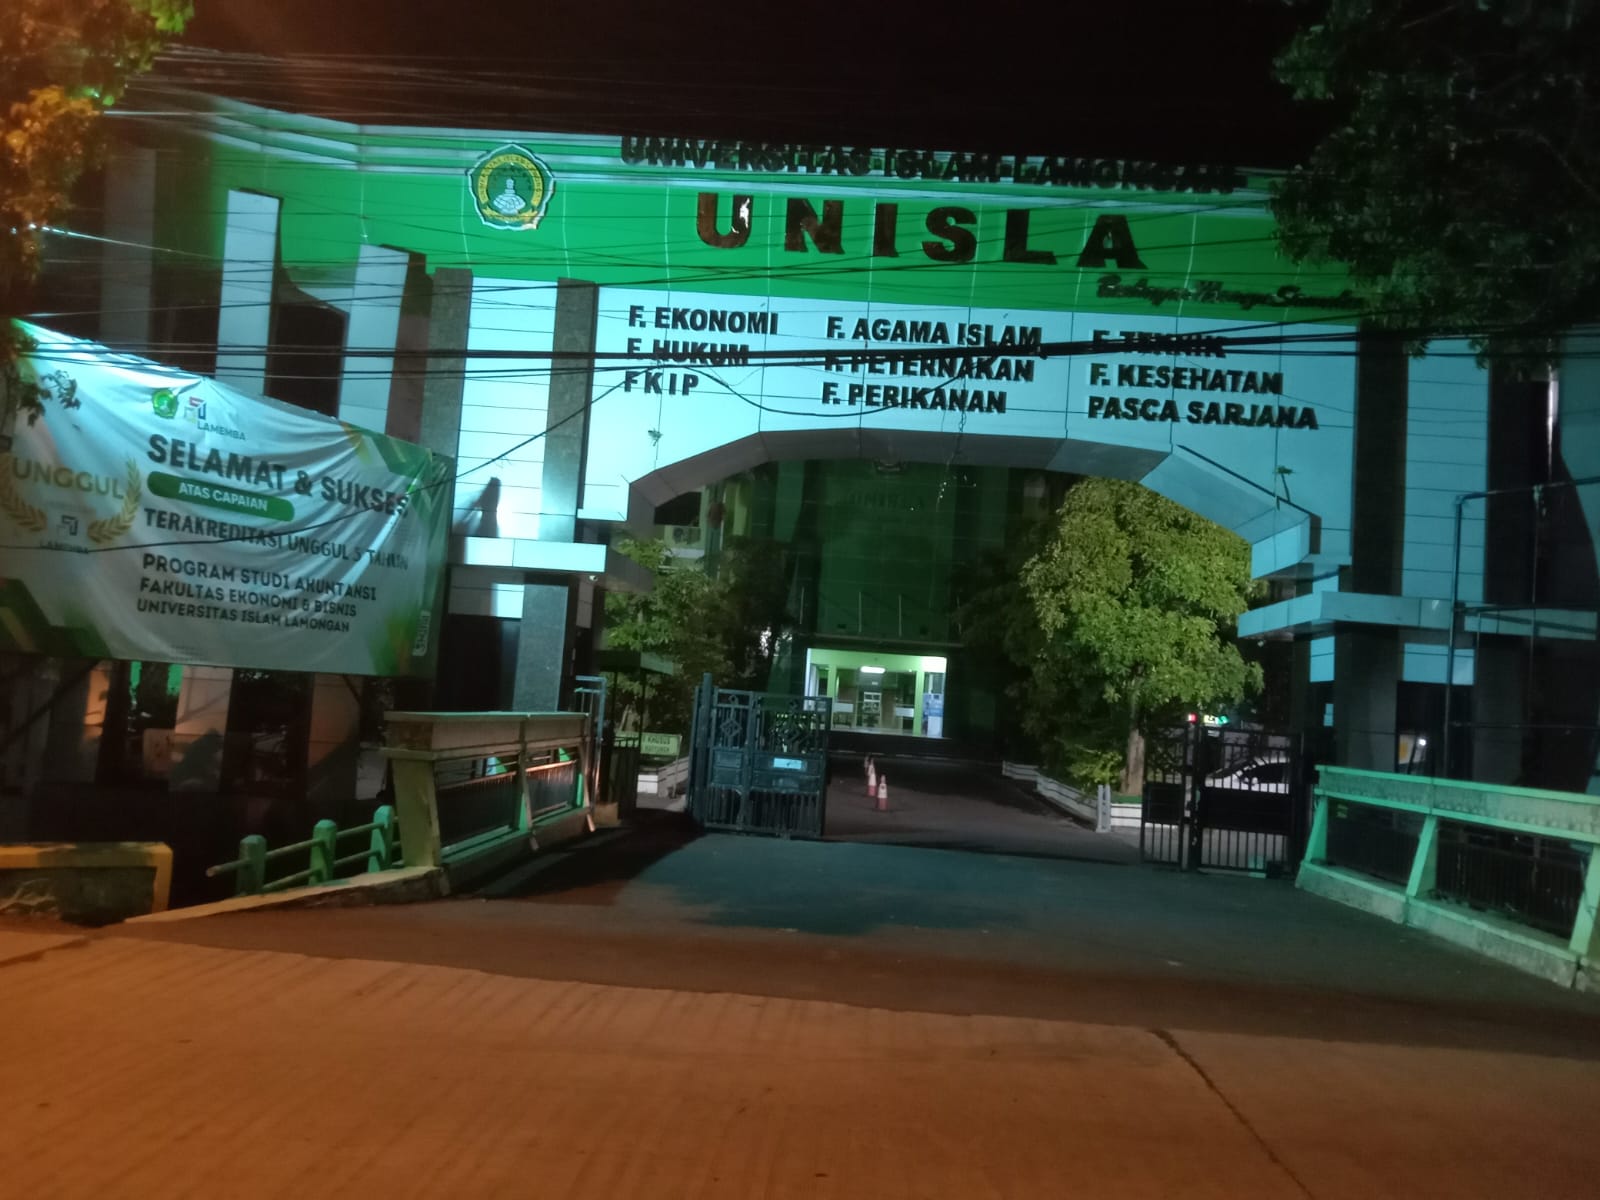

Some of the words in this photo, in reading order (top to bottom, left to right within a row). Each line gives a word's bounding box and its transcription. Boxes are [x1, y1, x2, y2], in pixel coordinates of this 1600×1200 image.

[696, 192, 1148, 269] UNISLA
[629, 305, 646, 328] F.
[655, 306, 778, 335] EKONOMI
[827, 316, 845, 339] F.
[852, 318, 950, 345] AGAMA
[957, 323, 1042, 348] ISLAM
[653, 339, 749, 366] HUKUM
[1090, 363, 1111, 386] F.
[1117, 364, 1284, 395] KESEHATAN
[822, 382, 841, 404] F.
[848, 383, 1007, 414] PERIKANAN
[1088, 396, 1180, 422] PASCA
[1187, 401, 1319, 430] SARJANA
[12, 458, 125, 500] UNGGUL
[147, 433, 286, 490] SELAMAT
[294, 470, 313, 497] &
[320, 476, 409, 518] SUKSES
[178, 483, 210, 499] ATAS
[212, 489, 268, 511] CAPAIAN
[144, 508, 283, 549] TERAKREDITASI
[287, 535, 350, 561] UNGGUL
[143, 553, 235, 581] PROGRAM
[240, 568, 290, 590] STUDI
[295, 577, 377, 601] AKUNTANSI
[140, 577, 224, 602] FAKULTAS
[229, 588, 297, 611] EKONOMI
[314, 600, 357, 617] BISNIS
[137, 598, 238, 622] UNIVERSITAS
[241, 611, 281, 627] ISLAM
[285, 617, 350, 633] LAMONGAN
